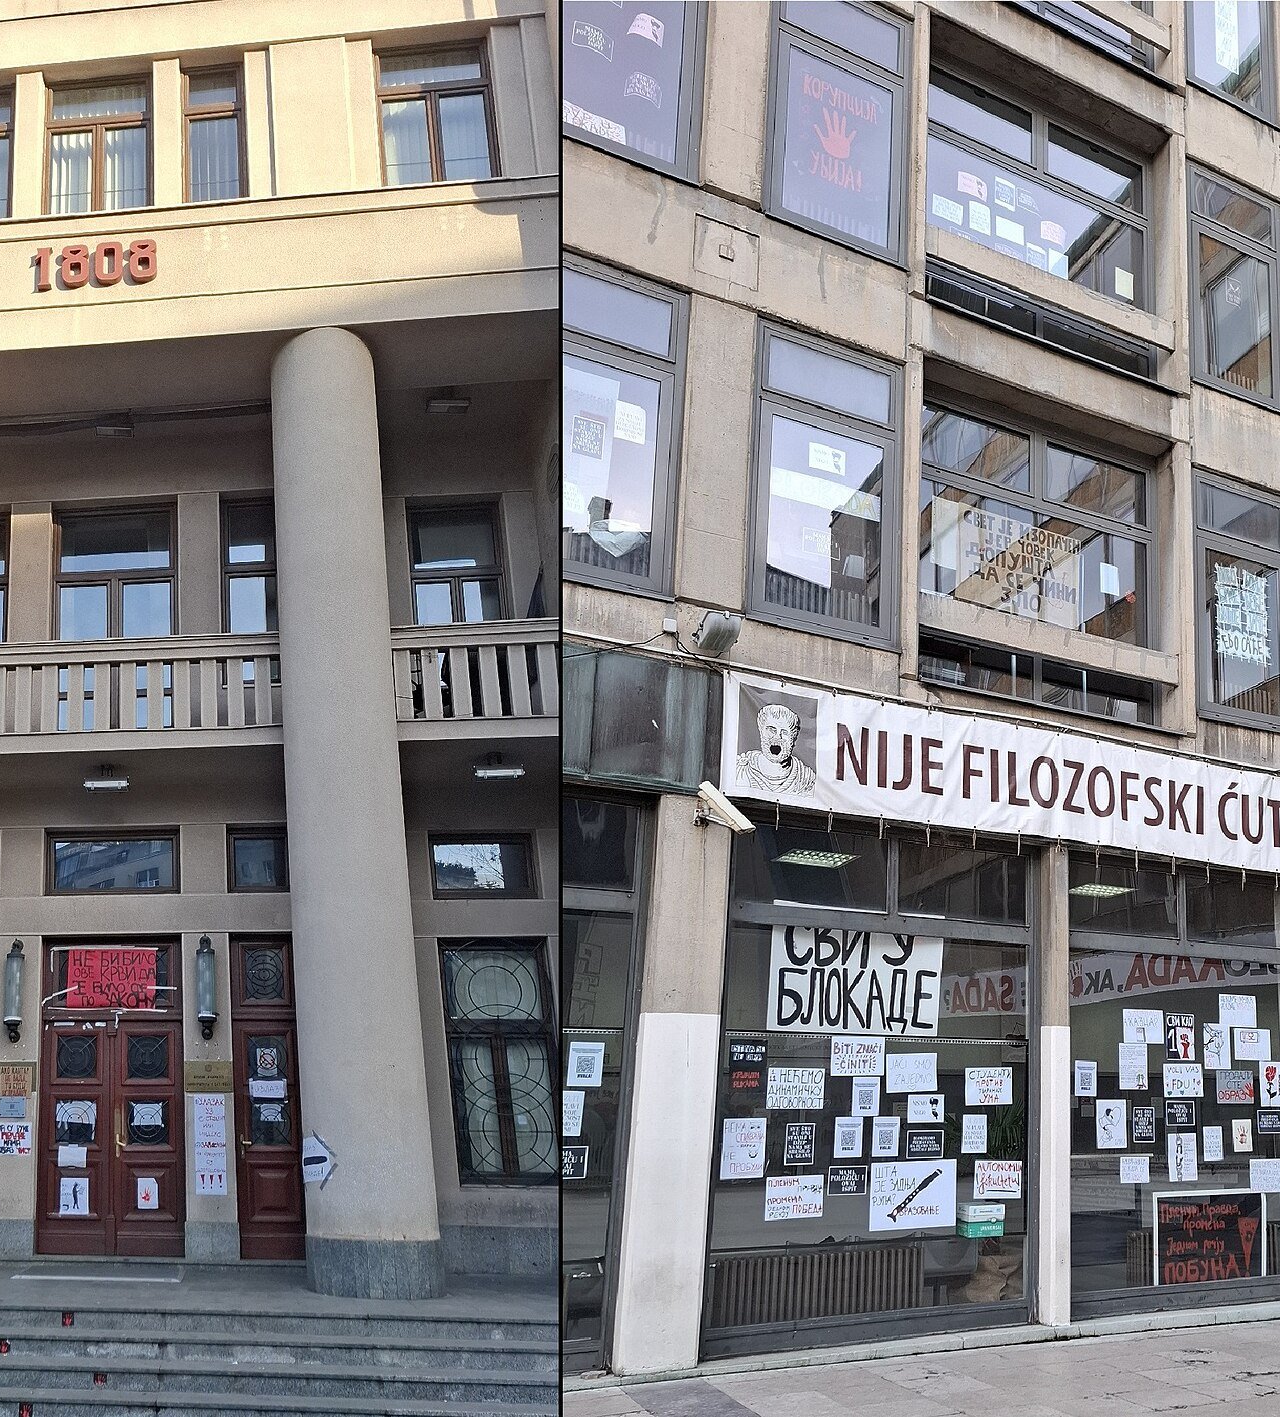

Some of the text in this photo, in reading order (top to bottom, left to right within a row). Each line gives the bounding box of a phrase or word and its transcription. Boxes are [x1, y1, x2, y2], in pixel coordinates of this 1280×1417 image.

[802, 74, 877, 125] КОРУПЦИЈА
[33, 239, 158, 292] 1808
[963, 509, 1081, 555] СВЕТ ЈЕ ИЗОПАЧЕН
[985, 532, 1011, 551] ЈЕР
[966, 541, 1055, 580] ДОПУШТА
[1005, 572, 1024, 591] СЕ
[835, 722, 945, 797] NIJE
[962, 742, 1206, 836] FILOZOFSKI
[785, 926, 915, 969] СВИ У
[72, 950, 156, 967] НЕ БИ БИЛО
[73, 965, 156, 981] ОВЕ КРВИ ДА
[81, 991, 156, 1009] ПО ЗАКОНУ
[777, 967, 938, 1034] БЛОКАДЕ
[1166, 1015, 1180, 1027] СВИ
[1181, 1015, 1193, 1027] КАО
[779, 1069, 824, 1085] НЕЋЕМО
[968, 1069, 1012, 1080] СТУДЕНТИ
[768, 1084, 823, 1097] ДИНАМИЧКУ
[976, 1079, 1004, 1088] ПРОТИВ
[1172, 1078, 1191, 1091] FDU
[1226, 1080, 1241, 1089] СТЕ
[979, 1093, 1000, 1104] УМА
[1218, 1089, 1247, 1101] ОБРАЗ
[767, 1097, 824, 1109] ОДГОВОРНОСТ
[875, 1166, 898, 1179] ШТА
[873, 1180, 886, 1193] ЈЕ
[767, 1195, 803, 1206] ПРОМЕНА
[792, 1203, 823, 1214] ПОБЕДА
